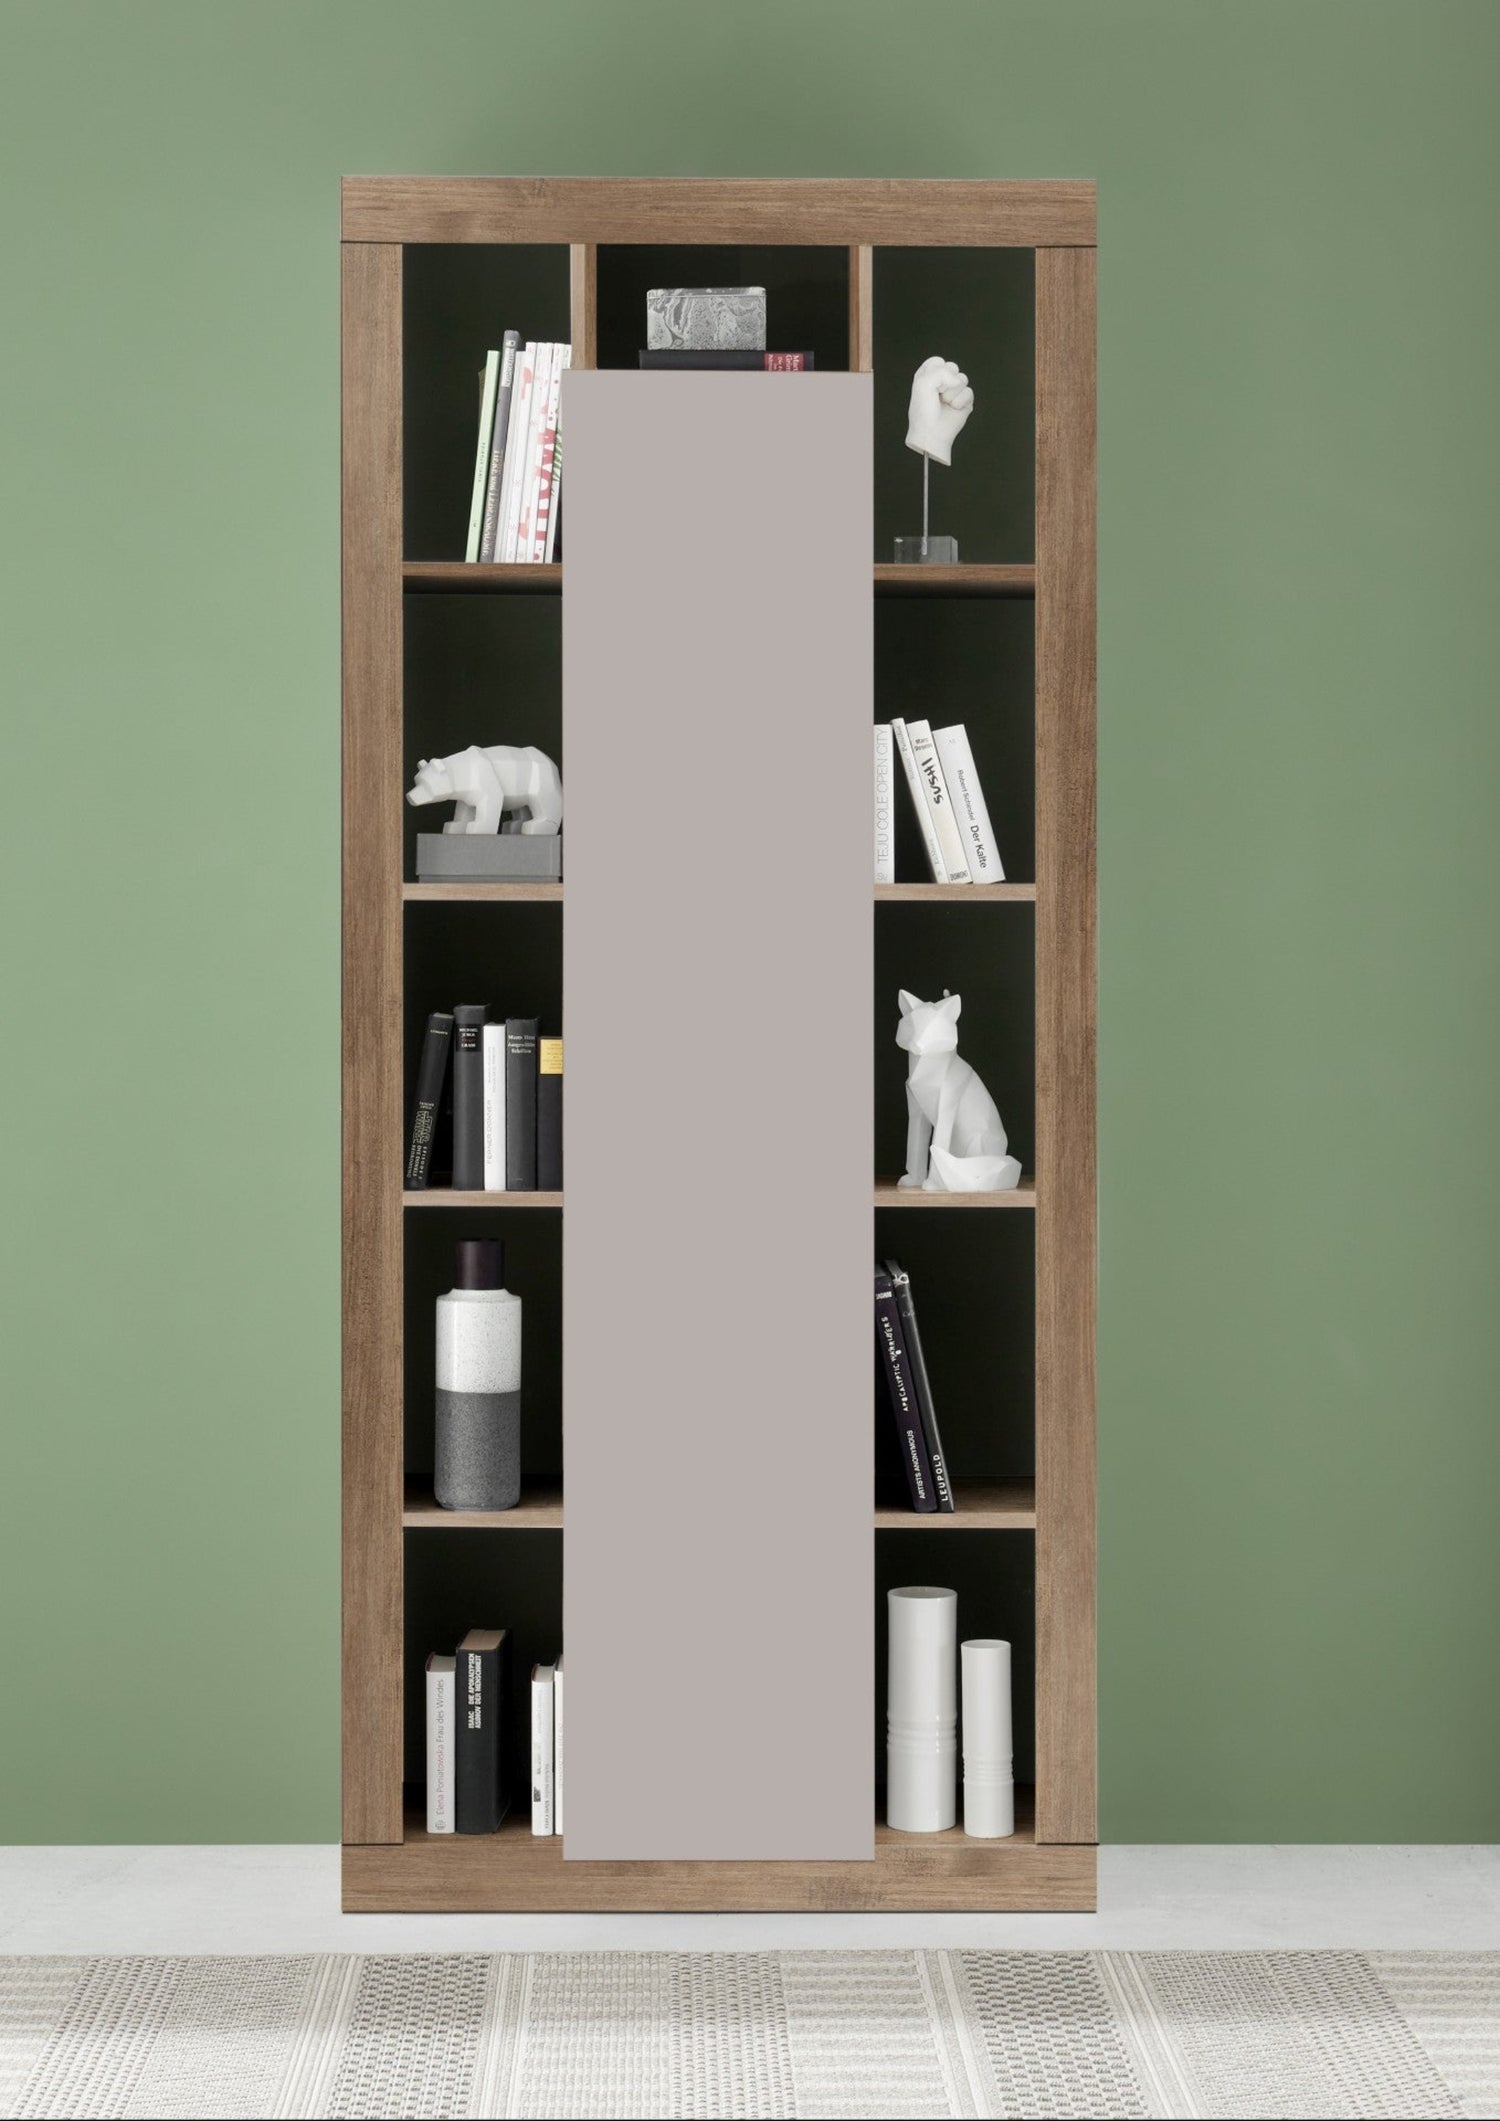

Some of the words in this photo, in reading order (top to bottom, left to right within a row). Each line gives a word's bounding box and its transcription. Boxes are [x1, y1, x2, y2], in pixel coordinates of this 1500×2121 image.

[876, 728, 889, 756] CITY
[876, 758, 889, 793] OPEN
[957, 769, 968, 793] Robert
[876, 796, 889, 830] COLE
[963, 790, 976, 821] Schindel
[876, 833, 889, 864] TEJU
[970, 824, 981, 843] Der
[975, 843, 987, 869] Kalte
[893, 1363, 909, 1412] APOCALYPTIC
[906, 1429, 921, 1472] ANONYMOUS
[914, 1471, 926, 1499] ARTISTS
[933, 1453, 948, 1502] LEUPOLD
[436, 1679, 444, 1709] Windes
[436, 1710, 444, 1724] des
[436, 1794, 444, 1815] Elena
